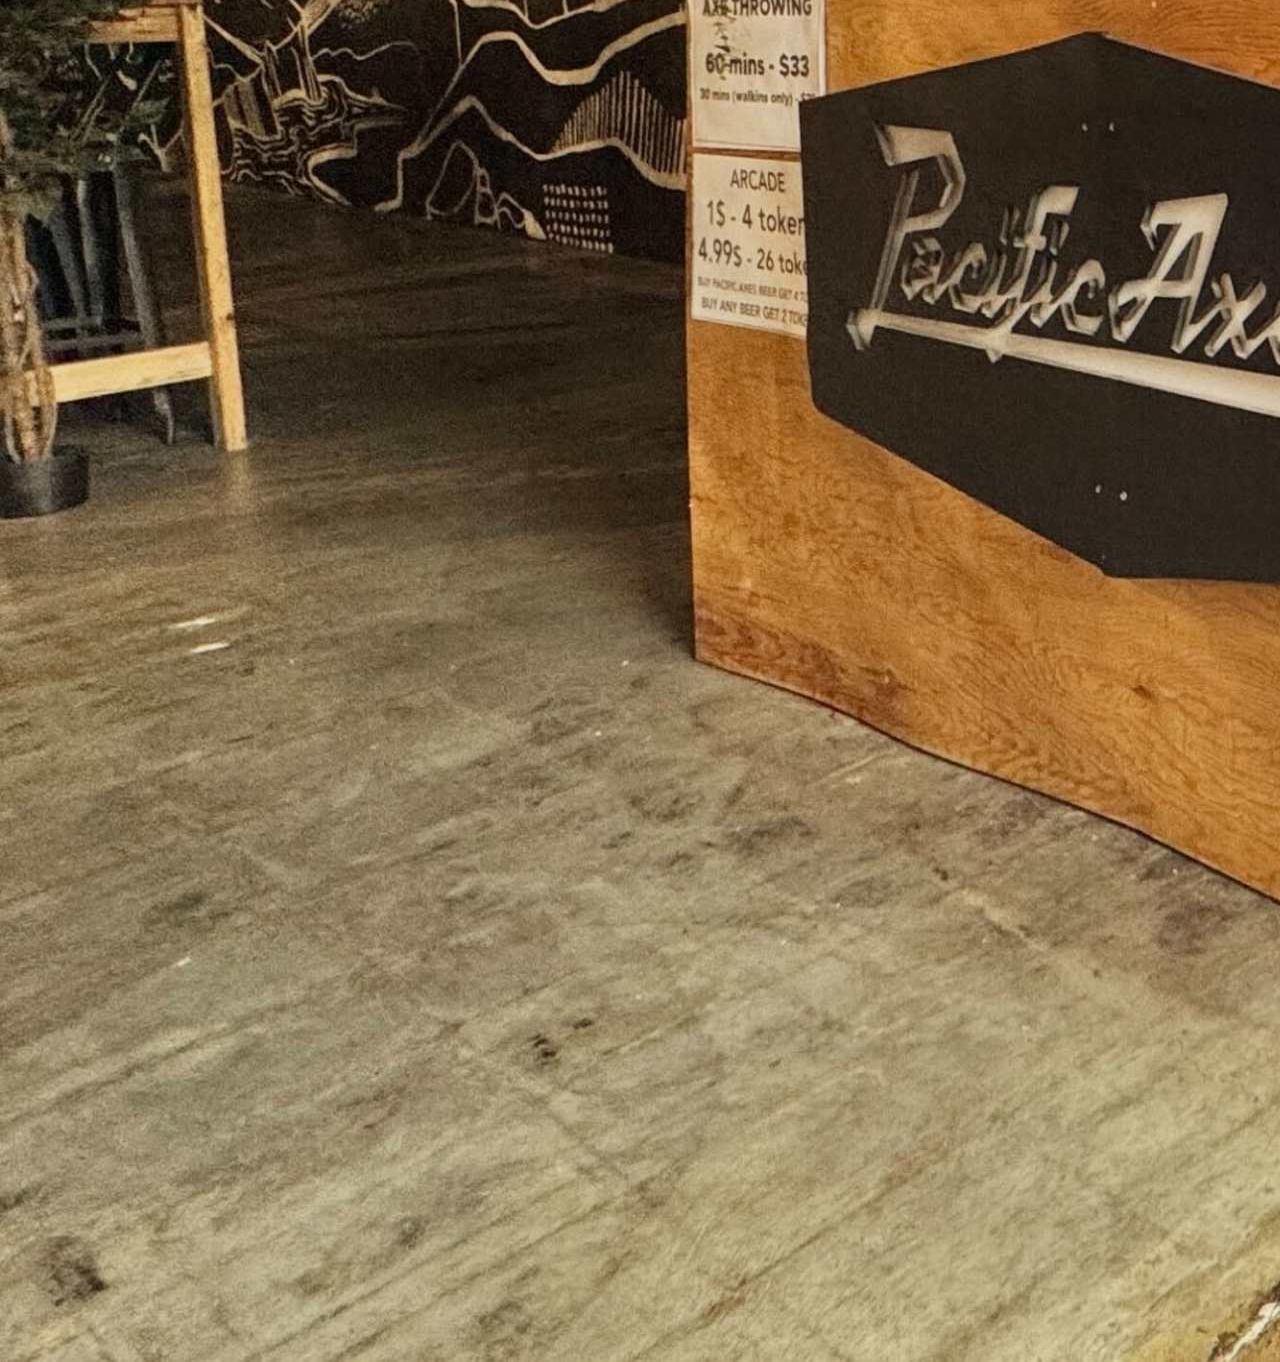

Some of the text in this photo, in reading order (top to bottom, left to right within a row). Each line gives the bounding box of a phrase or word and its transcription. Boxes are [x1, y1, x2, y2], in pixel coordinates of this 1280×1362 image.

[705, 51, 810, 78] 60 mins $33
[770, 91, 794, 108] only)
[730, 169, 786, 193] ARCADE
[706, 199, 726, 228] 1$
[741, 202, 754, 231] 4
[862, 122, 1106, 348] Pacific
[698, 237, 776, 272] 4.99$ 26
[701, 296, 718, 310] BUY
[719, 299, 738, 314] ANY
[740, 302, 761, 317] BEER
[763, 305, 780, 320] GET
